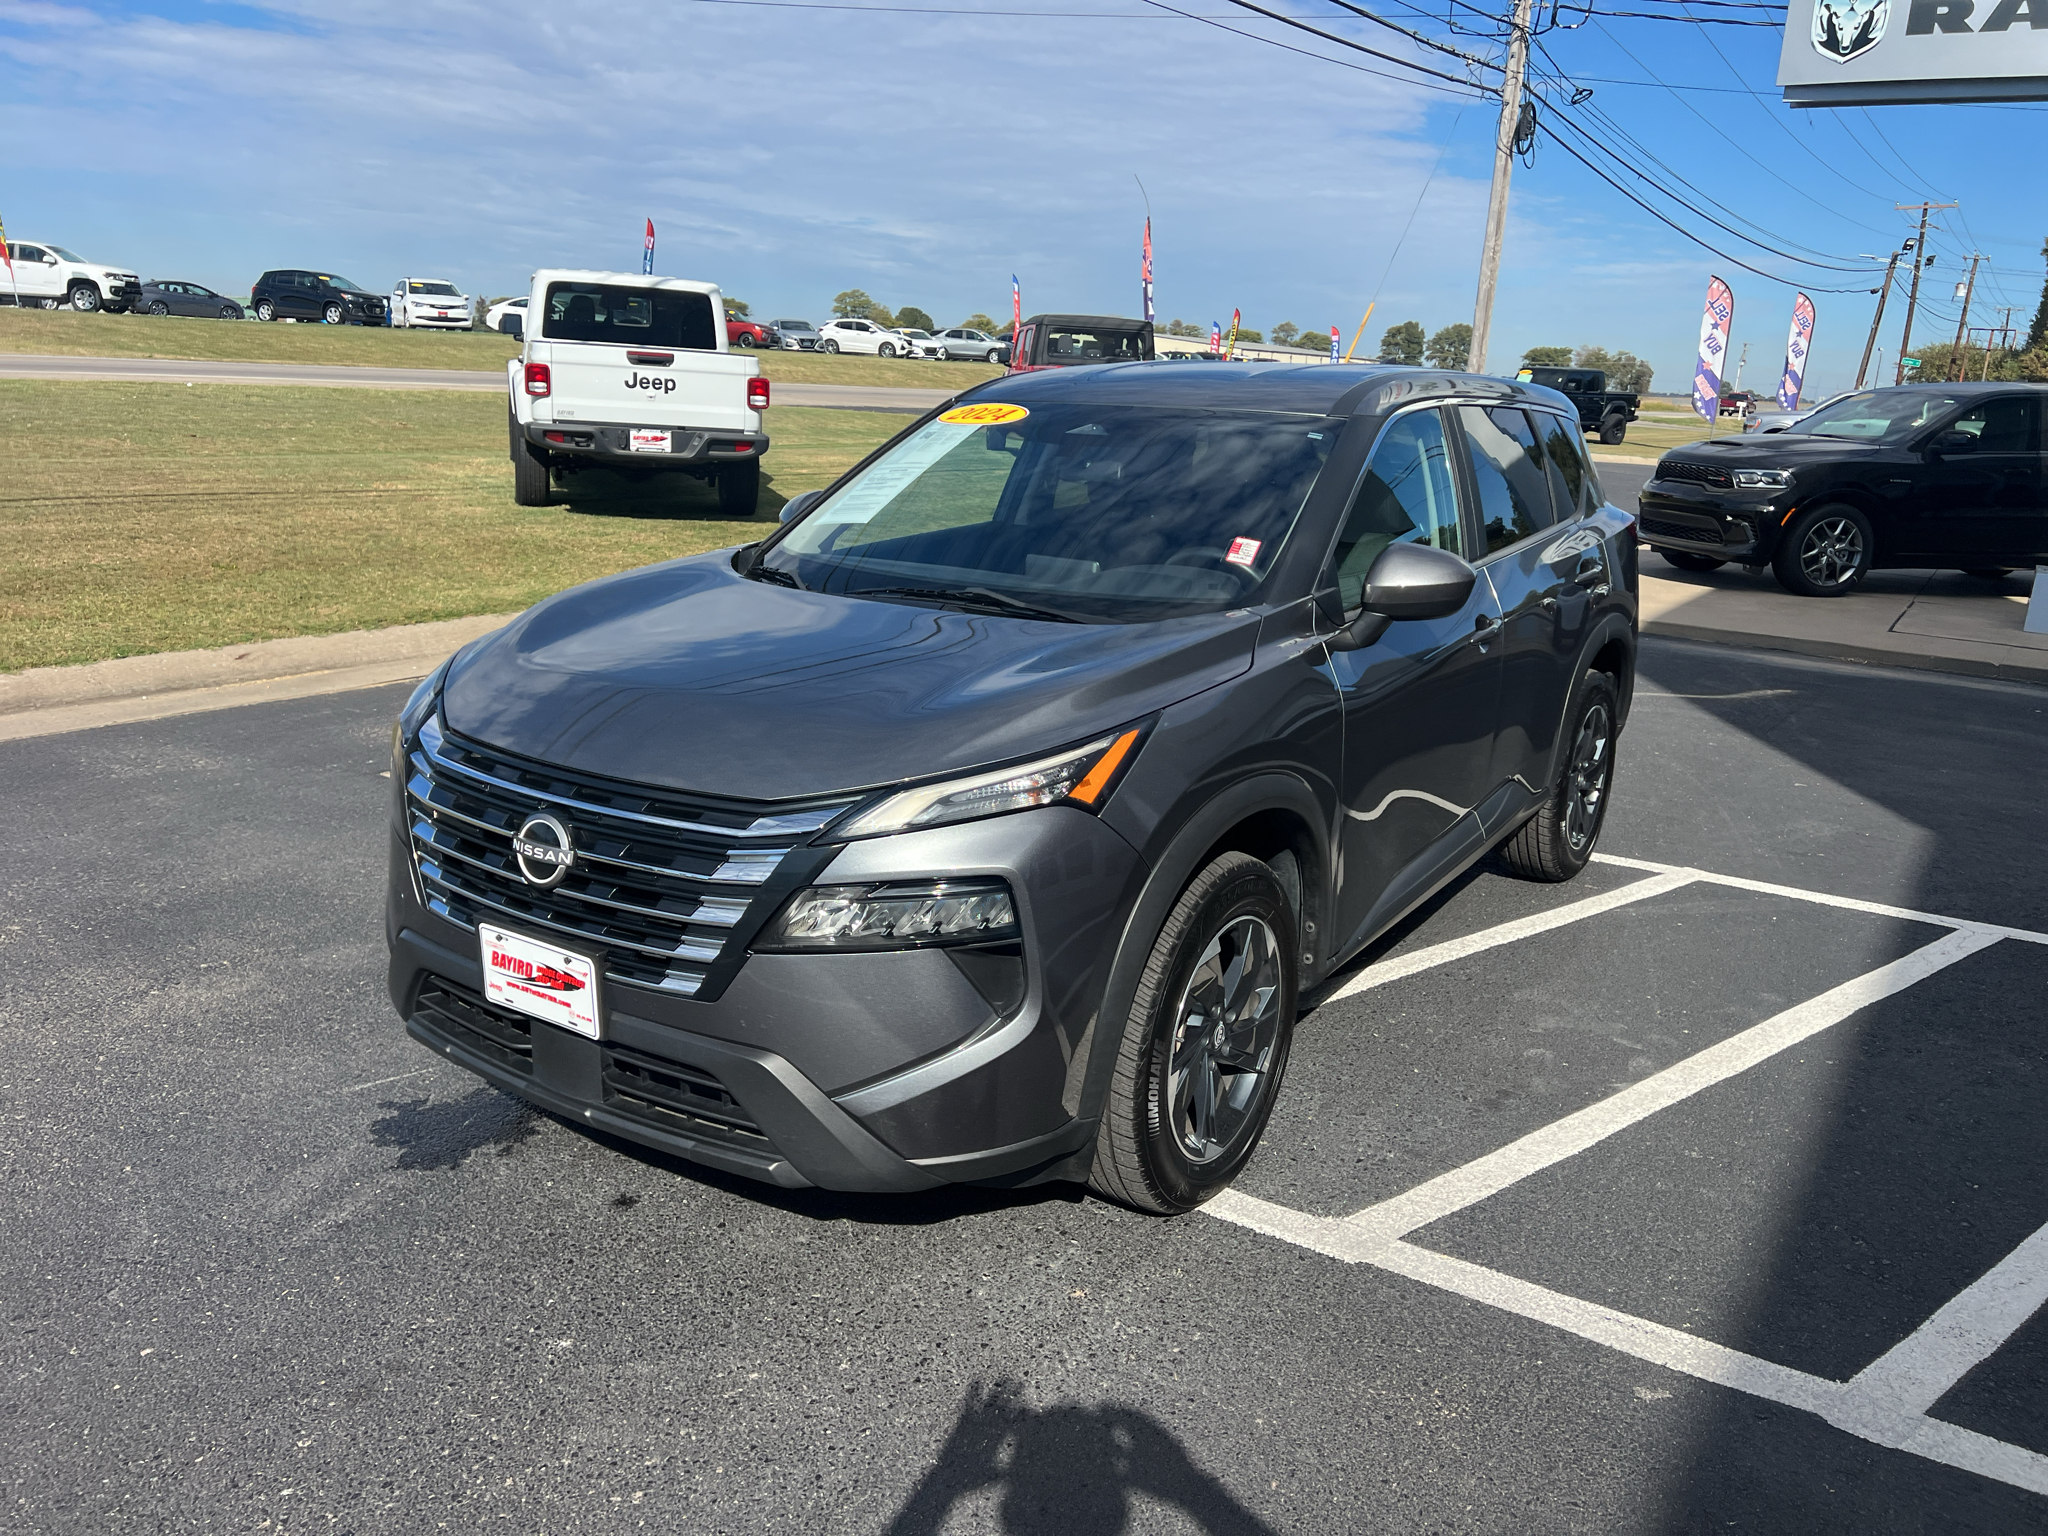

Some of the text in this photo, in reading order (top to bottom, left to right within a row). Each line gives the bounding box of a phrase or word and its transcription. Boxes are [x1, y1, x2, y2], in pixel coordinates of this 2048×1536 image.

[624, 372, 677, 394] Jeep
[945, 407, 1019, 421] 2024
[512, 838, 571, 864] NISSAN
[491, 950, 533, 979] BAYIRD
